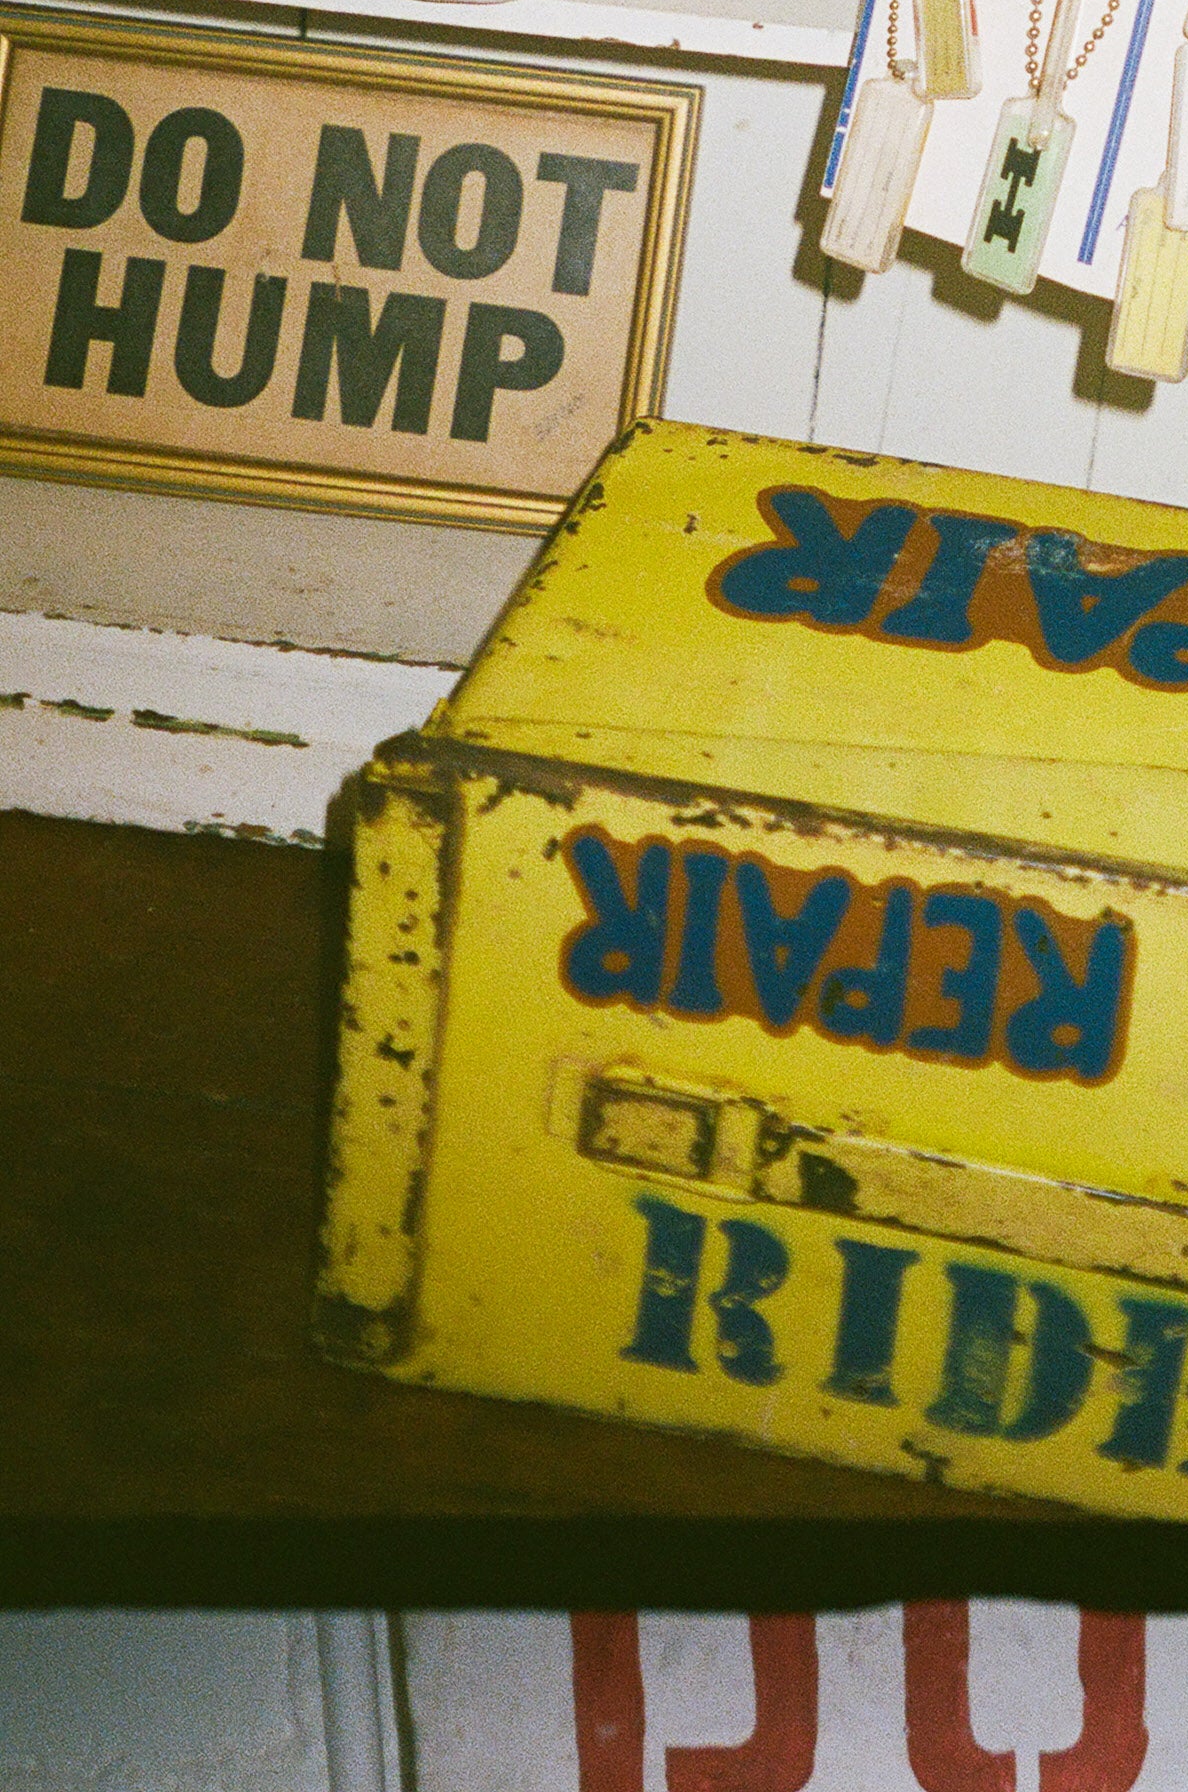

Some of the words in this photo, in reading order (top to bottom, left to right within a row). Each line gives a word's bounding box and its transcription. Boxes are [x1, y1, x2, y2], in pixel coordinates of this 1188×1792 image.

[20, 85, 245, 244] DO
[300, 123, 641, 297] NOT
[43, 247, 566, 443] HUMP
[567, 831, 1130, 1085] REPAIR
